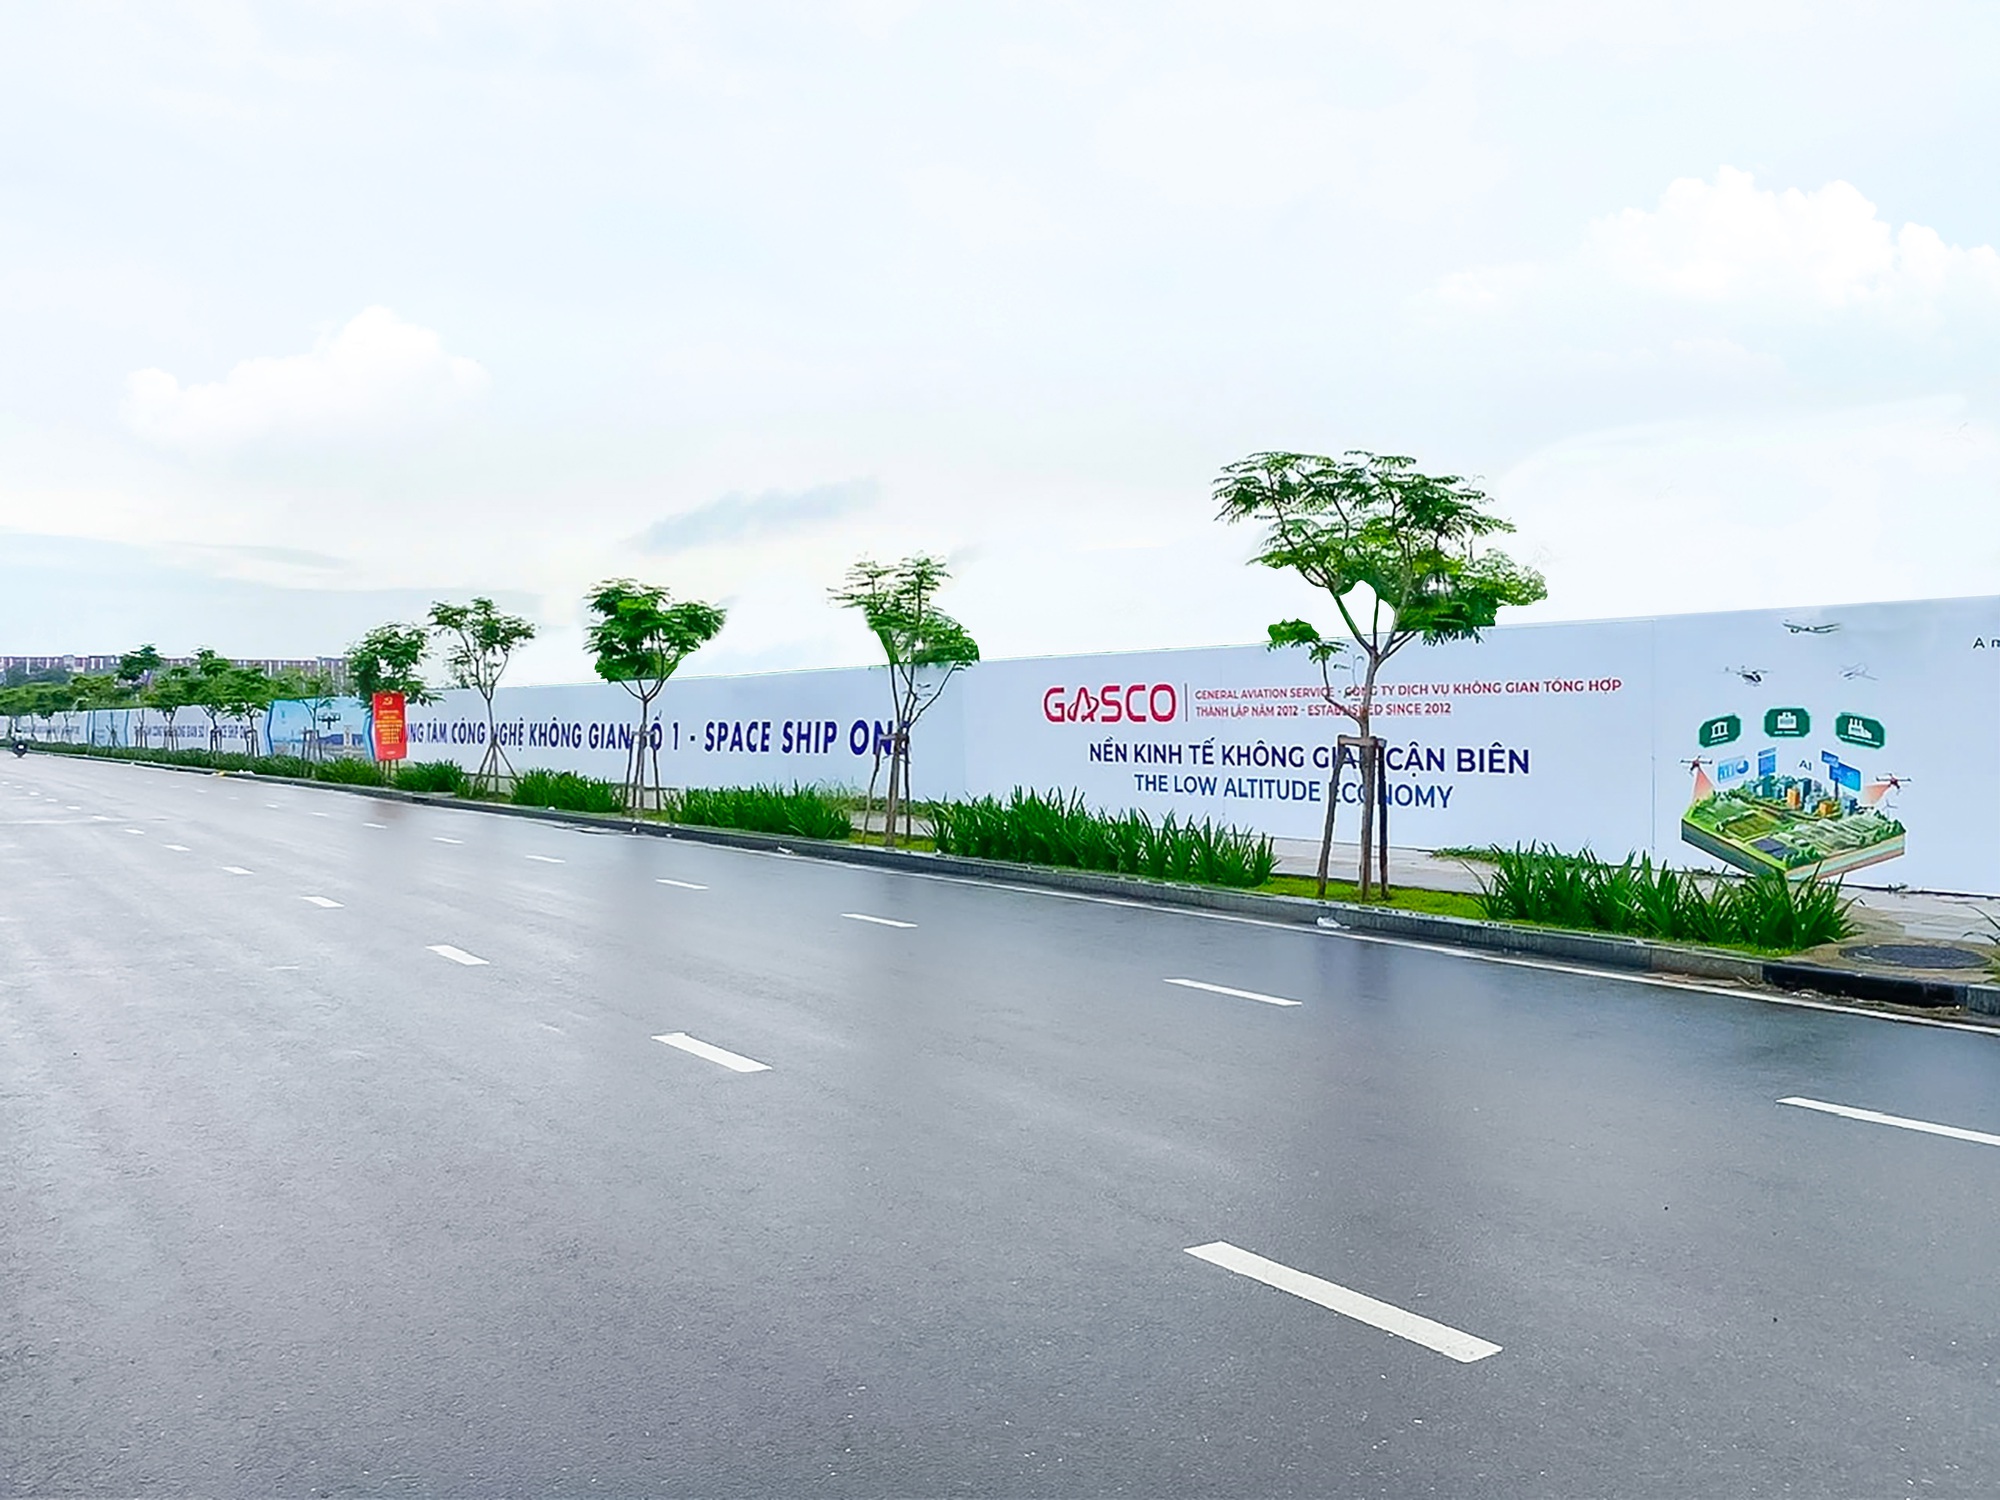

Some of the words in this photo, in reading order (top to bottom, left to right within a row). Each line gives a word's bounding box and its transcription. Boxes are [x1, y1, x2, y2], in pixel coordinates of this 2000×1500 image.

[1043, 683, 1177, 723] GASCO
[1195, 689, 1239, 700] GENERAL
[1241, 687, 1288, 699] AVIATION
[1381, 685, 1395, 696] TY
[1505, 681, 1540, 693] GIAN
[1277, 705, 1298, 716] 2012
[1386, 703, 1422, 716] SINCE
[1424, 702, 1451, 714] 2012
[452, 717, 485, 744] CÔNG
[530, 716, 580, 749] KHÔNG
[589, 722, 630, 749] GIAN
[673, 722, 679, 750] 1
[704, 720, 771, 753] SPACE
[782, 720, 838, 754] SHIP
[1134, 743, 1182, 765] KINH
[1188, 737, 1215, 765] TẾ
[1221, 740, 1304, 768] KHÔNG
[1312, 746, 1377, 770] GIA
[1386, 741, 1445, 777] CẬN
[1456, 742, 1530, 774] BIÊN
[1134, 774, 1168, 792] THE
[1174, 775, 1217, 796] LOW
[1223, 777, 1321, 801] ALTITUDE
